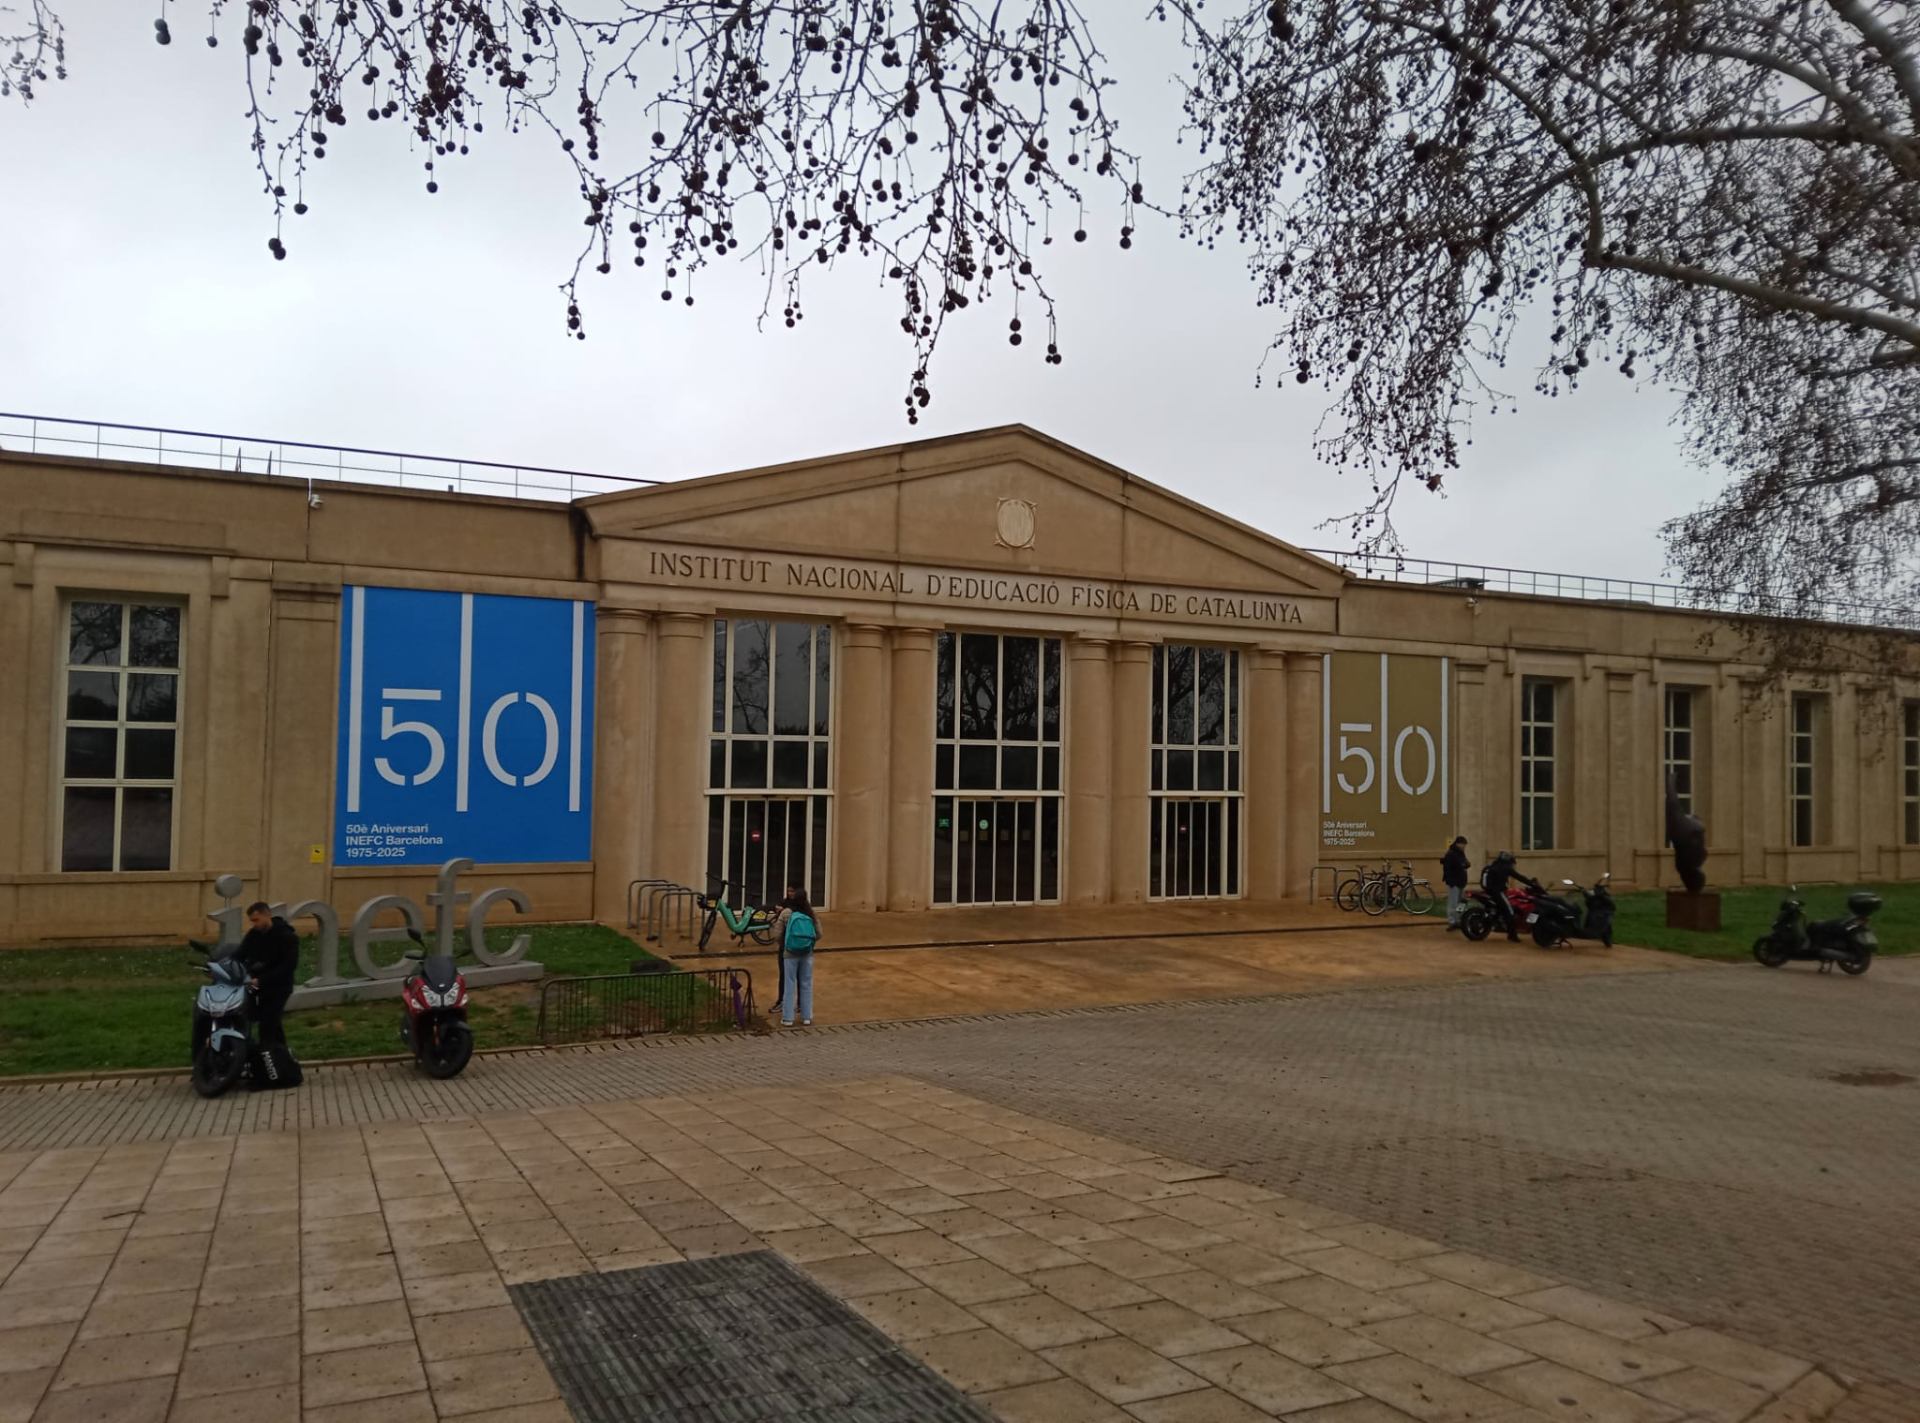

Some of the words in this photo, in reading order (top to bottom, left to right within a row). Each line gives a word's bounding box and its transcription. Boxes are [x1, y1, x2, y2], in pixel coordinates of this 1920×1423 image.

[650, 551, 772, 583] INSTITUT
[787, 563, 913, 594] NACIONAL
[927, 574, 1060, 605] D'EDUCACIÓ
[1071, 583, 1140, 611] FÍSICA
[1151, 593, 1177, 614] DE
[1186, 596, 1303, 624] CATALUNYA
[345, 824, 368, 834] 50è
[371, 823, 429, 834] Aniversari
[345, 835, 384, 846] INEFC
[385, 834, 444, 846] Barcelona
[345, 847, 406, 858] 1975-2025
